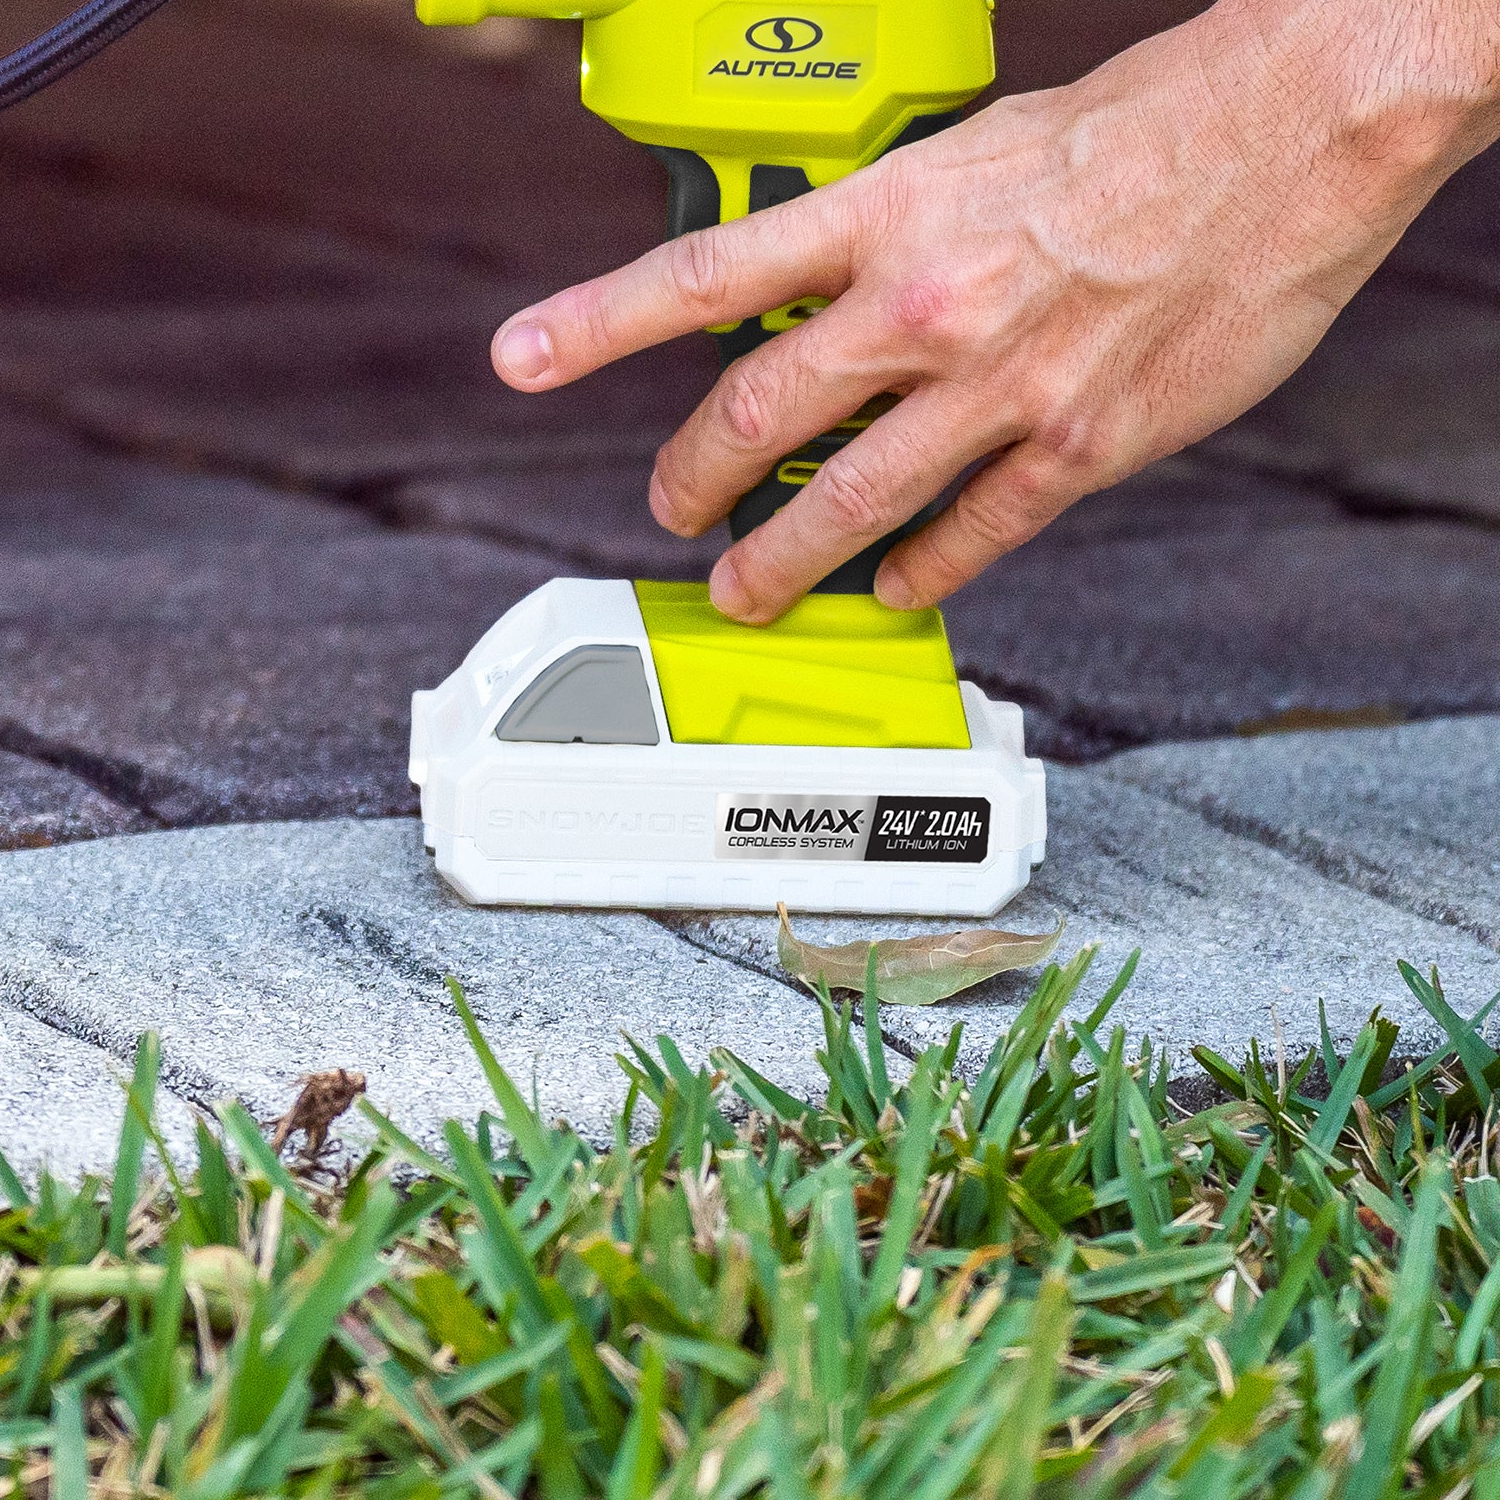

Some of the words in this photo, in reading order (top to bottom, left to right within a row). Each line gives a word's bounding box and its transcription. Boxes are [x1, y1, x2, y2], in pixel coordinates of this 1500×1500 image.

[707, 59, 862, 80] AUTOJOE
[923, 810, 983, 837] 2.0Ah
[727, 836, 797, 848] CORDLESS
[799, 837, 855, 849] SYSTEM
[885, 838, 940, 850] LITHIUM
[942, 839, 968, 850] ION
